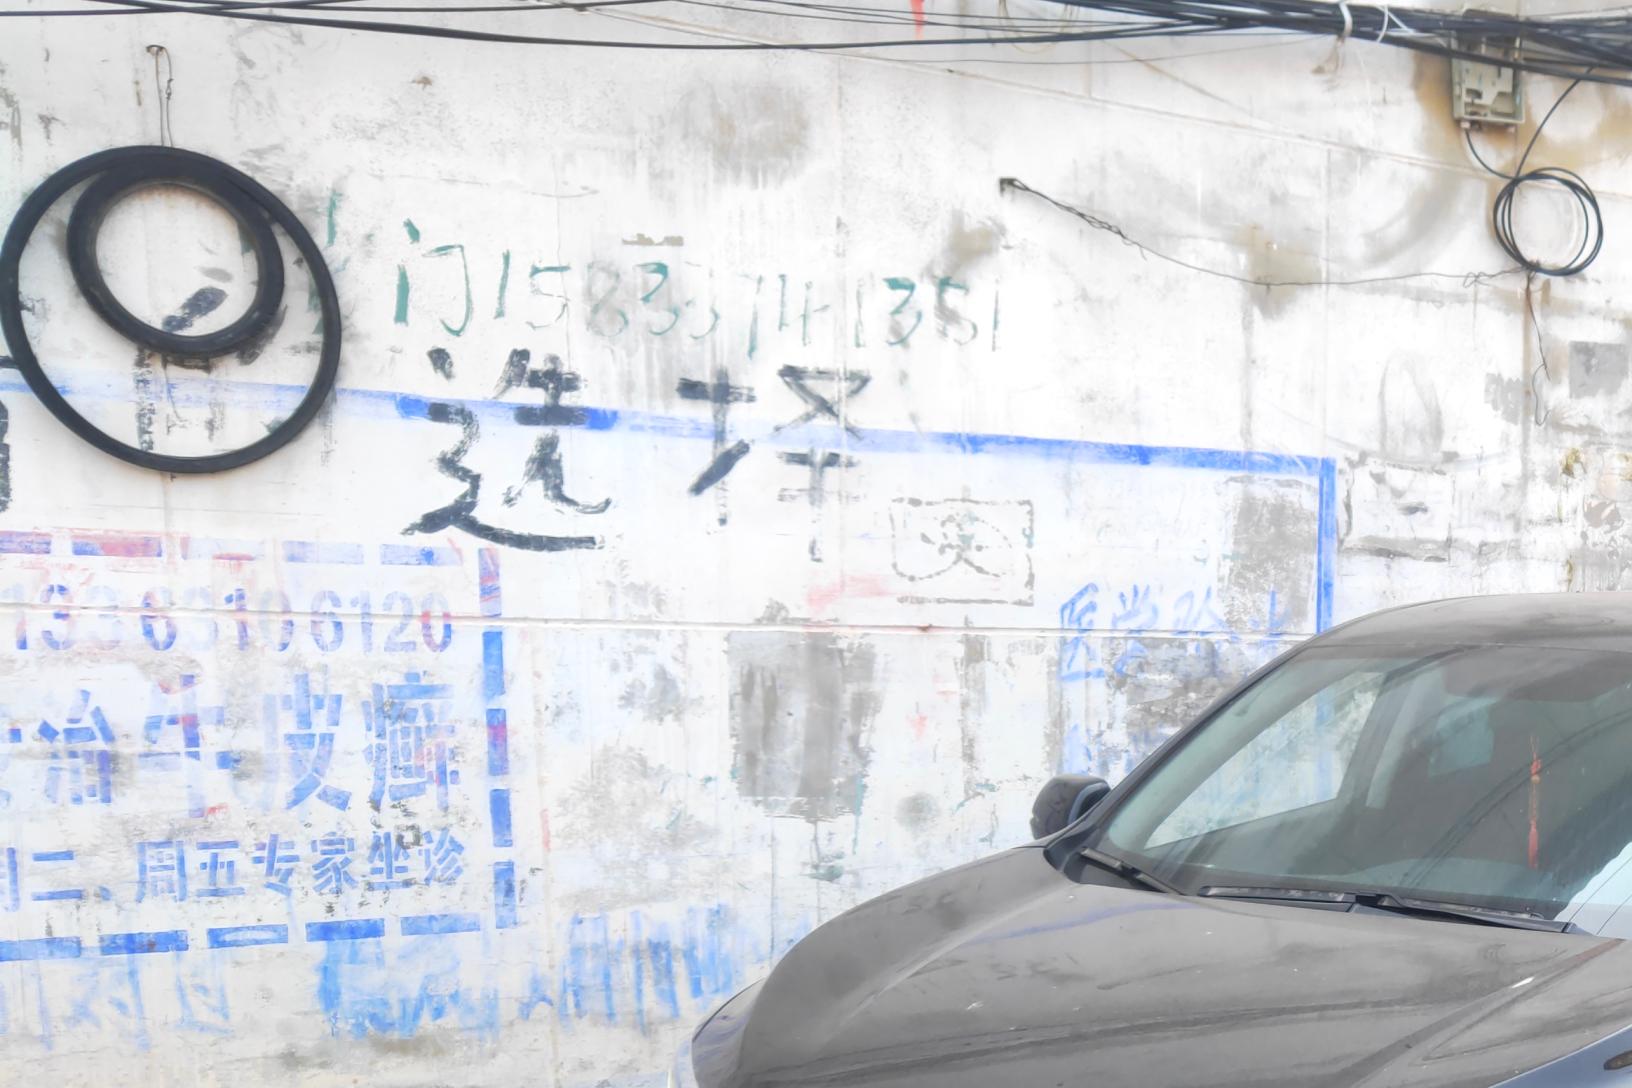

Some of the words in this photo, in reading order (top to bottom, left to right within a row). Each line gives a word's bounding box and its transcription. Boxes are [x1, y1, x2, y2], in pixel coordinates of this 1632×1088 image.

[0, 828, 466, 906] 二、周五专家坐诊
